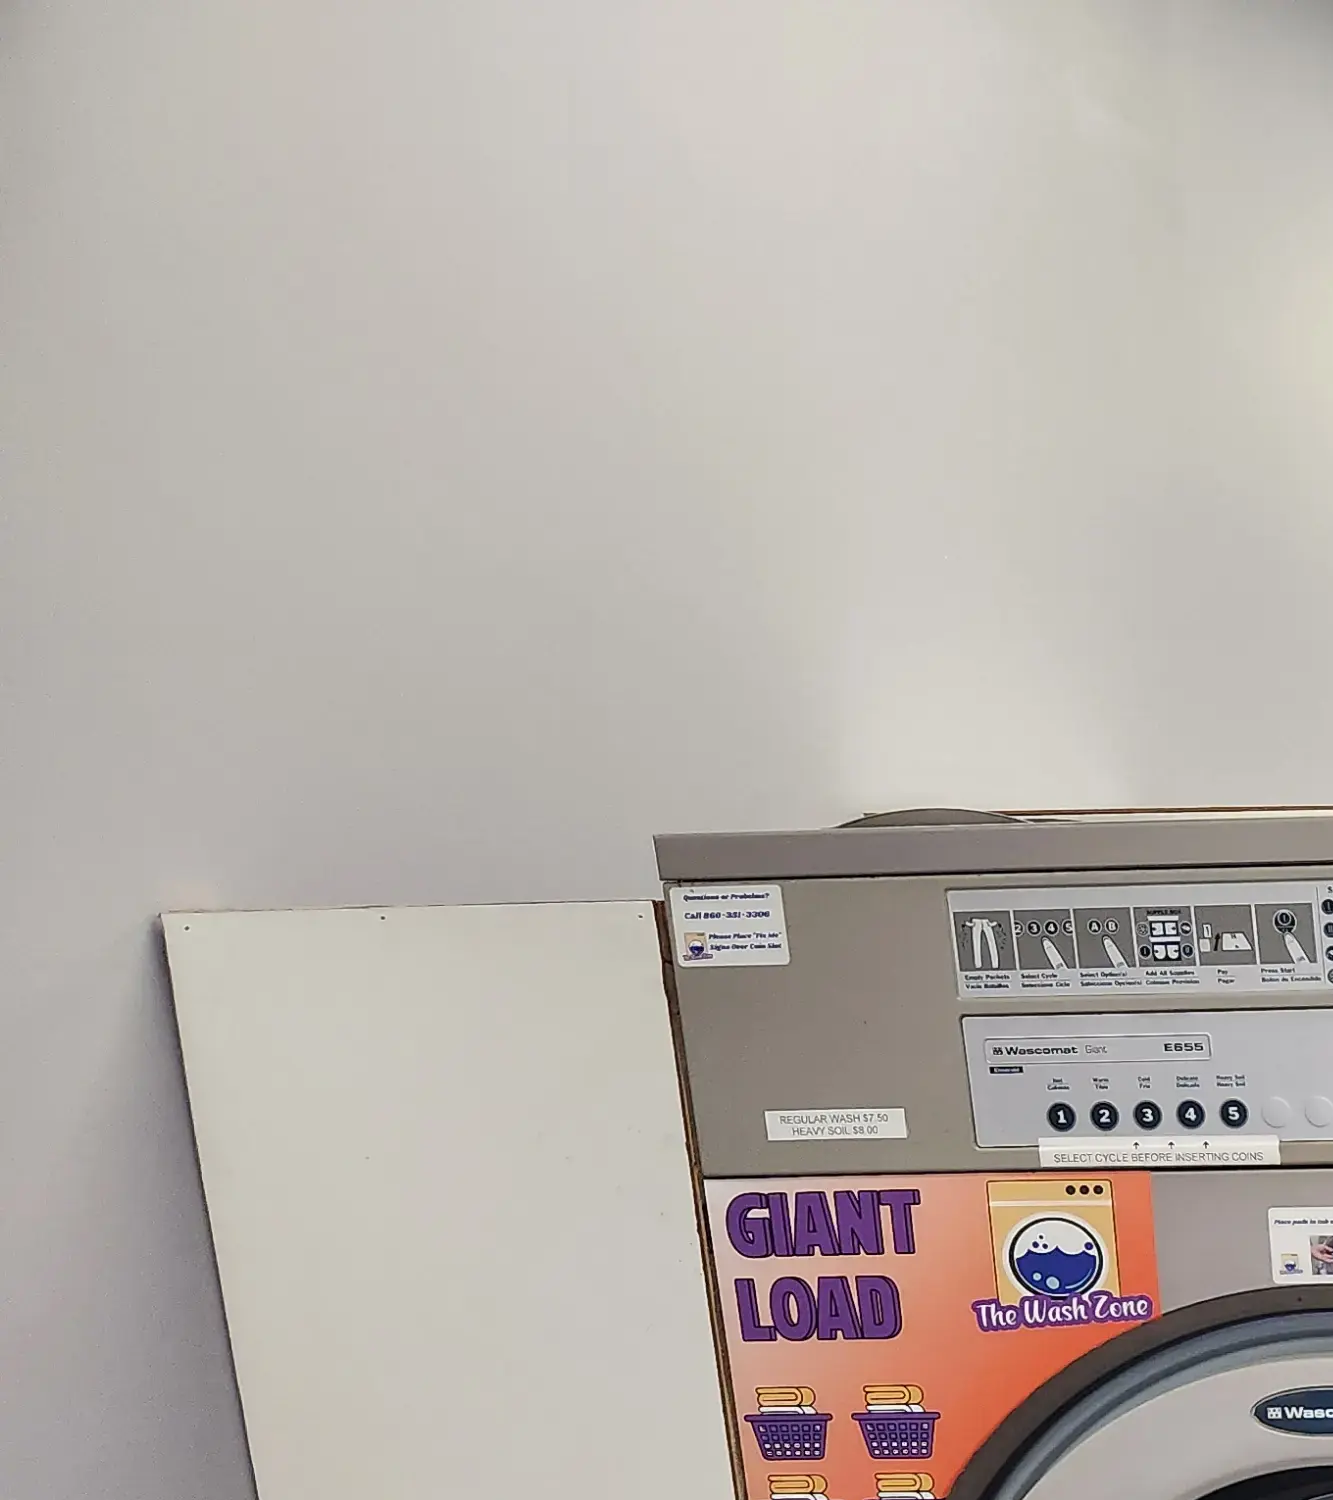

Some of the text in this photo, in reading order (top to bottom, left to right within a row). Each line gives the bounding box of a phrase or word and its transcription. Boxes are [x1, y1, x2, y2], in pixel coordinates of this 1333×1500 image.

[683, 894, 719, 902] Questions
[684, 912, 701, 920] Call
[1031, 923, 1040, 933] 3
[1047, 922, 1056, 932] 4
[1090, 921, 1116, 932] A B
[1004, 1045, 1078, 1055] Wascomat
[1164, 1042, 1204, 1052] E655
[780, 1114, 828, 1124] REGULAR
[829, 1114, 861, 1123] WASH
[1057, 1109, 1067, 1123] 1
[1099, 1109, 1111, 1123] 2
[1142, 1108, 1153, 1122] 3
[1185, 1107, 1196, 1121] 4
[1228, 1106, 1239, 1120] 5
[792, 1126, 825, 1136] HEAVY
[828, 1126, 850, 1135] SOIL
[1054, 1151, 1264, 1163] SELECT CYCLE BEFORE INSERTING COINS
[726, 1189, 921, 1258] GIANT
[734, 1276, 902, 1342] LOAD
[977, 1292, 1148, 1329] The Wash Zone
